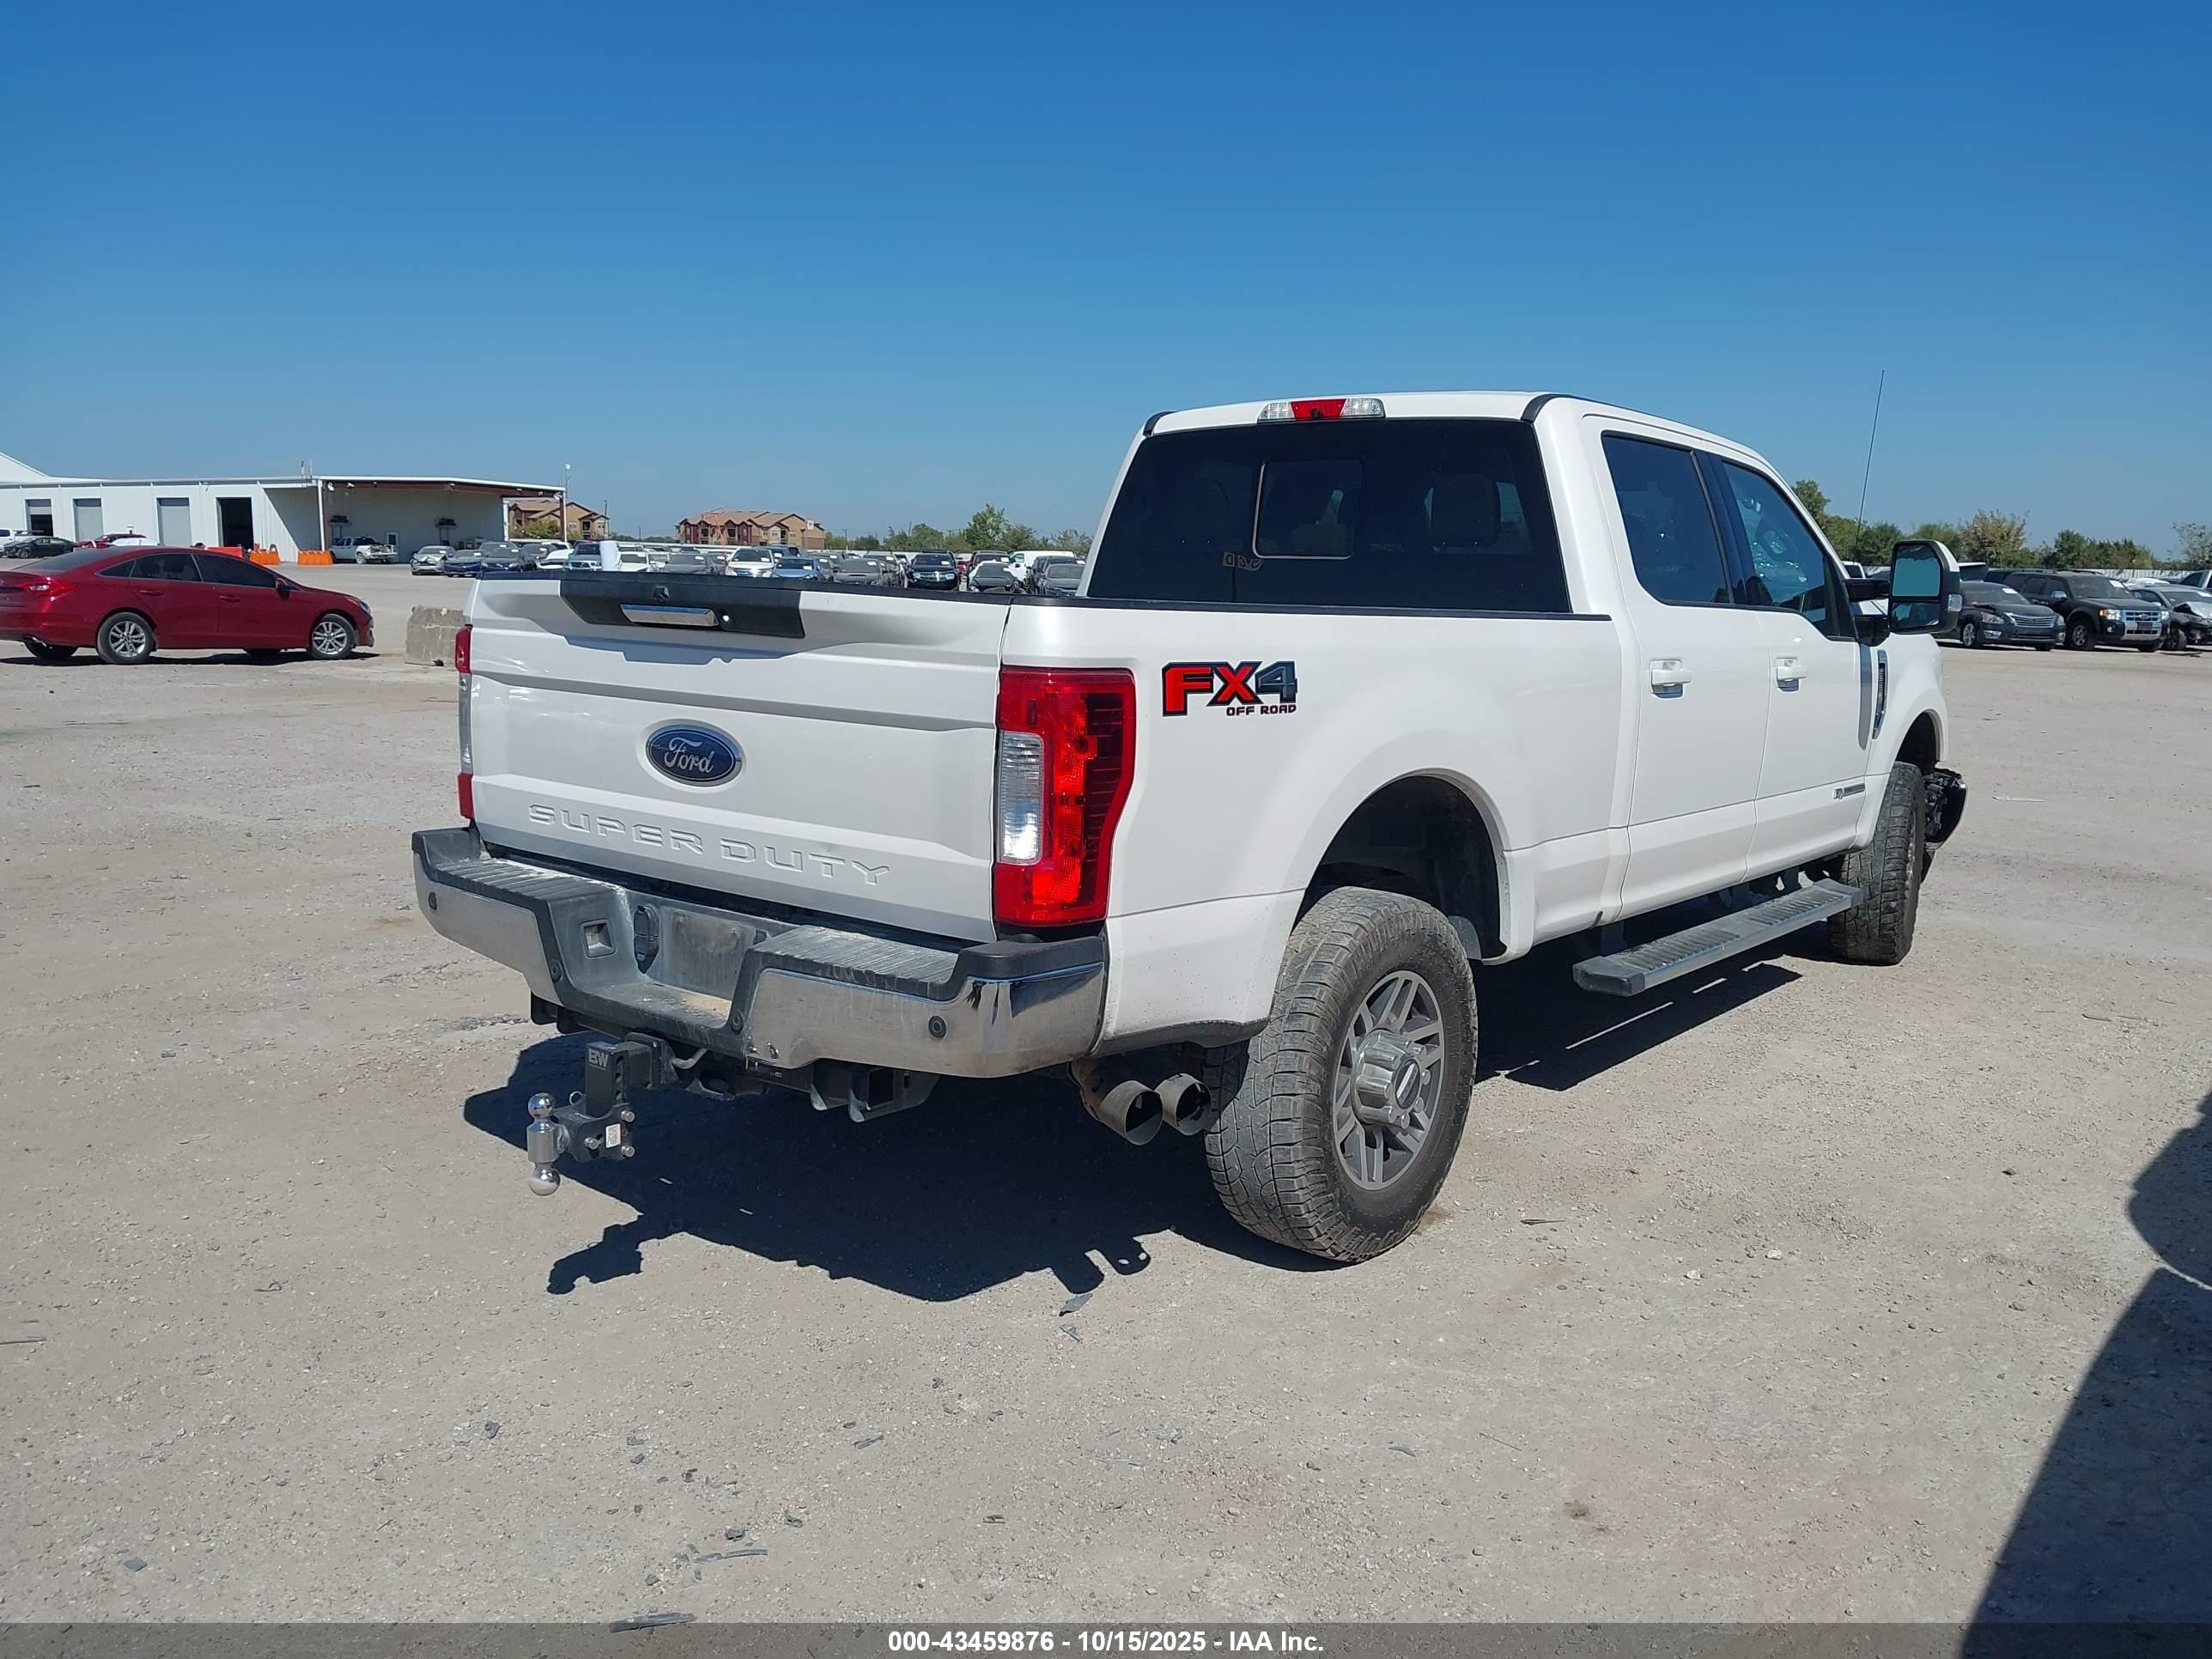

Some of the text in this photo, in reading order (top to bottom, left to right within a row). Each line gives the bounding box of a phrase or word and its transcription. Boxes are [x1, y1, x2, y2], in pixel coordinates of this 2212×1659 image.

[1162, 660, 1297, 716] FX4
[1226, 704, 1297, 716] OFF ROAD
[665, 737, 715, 773] Ford
[528, 803, 890, 886] SUPER DUTY
